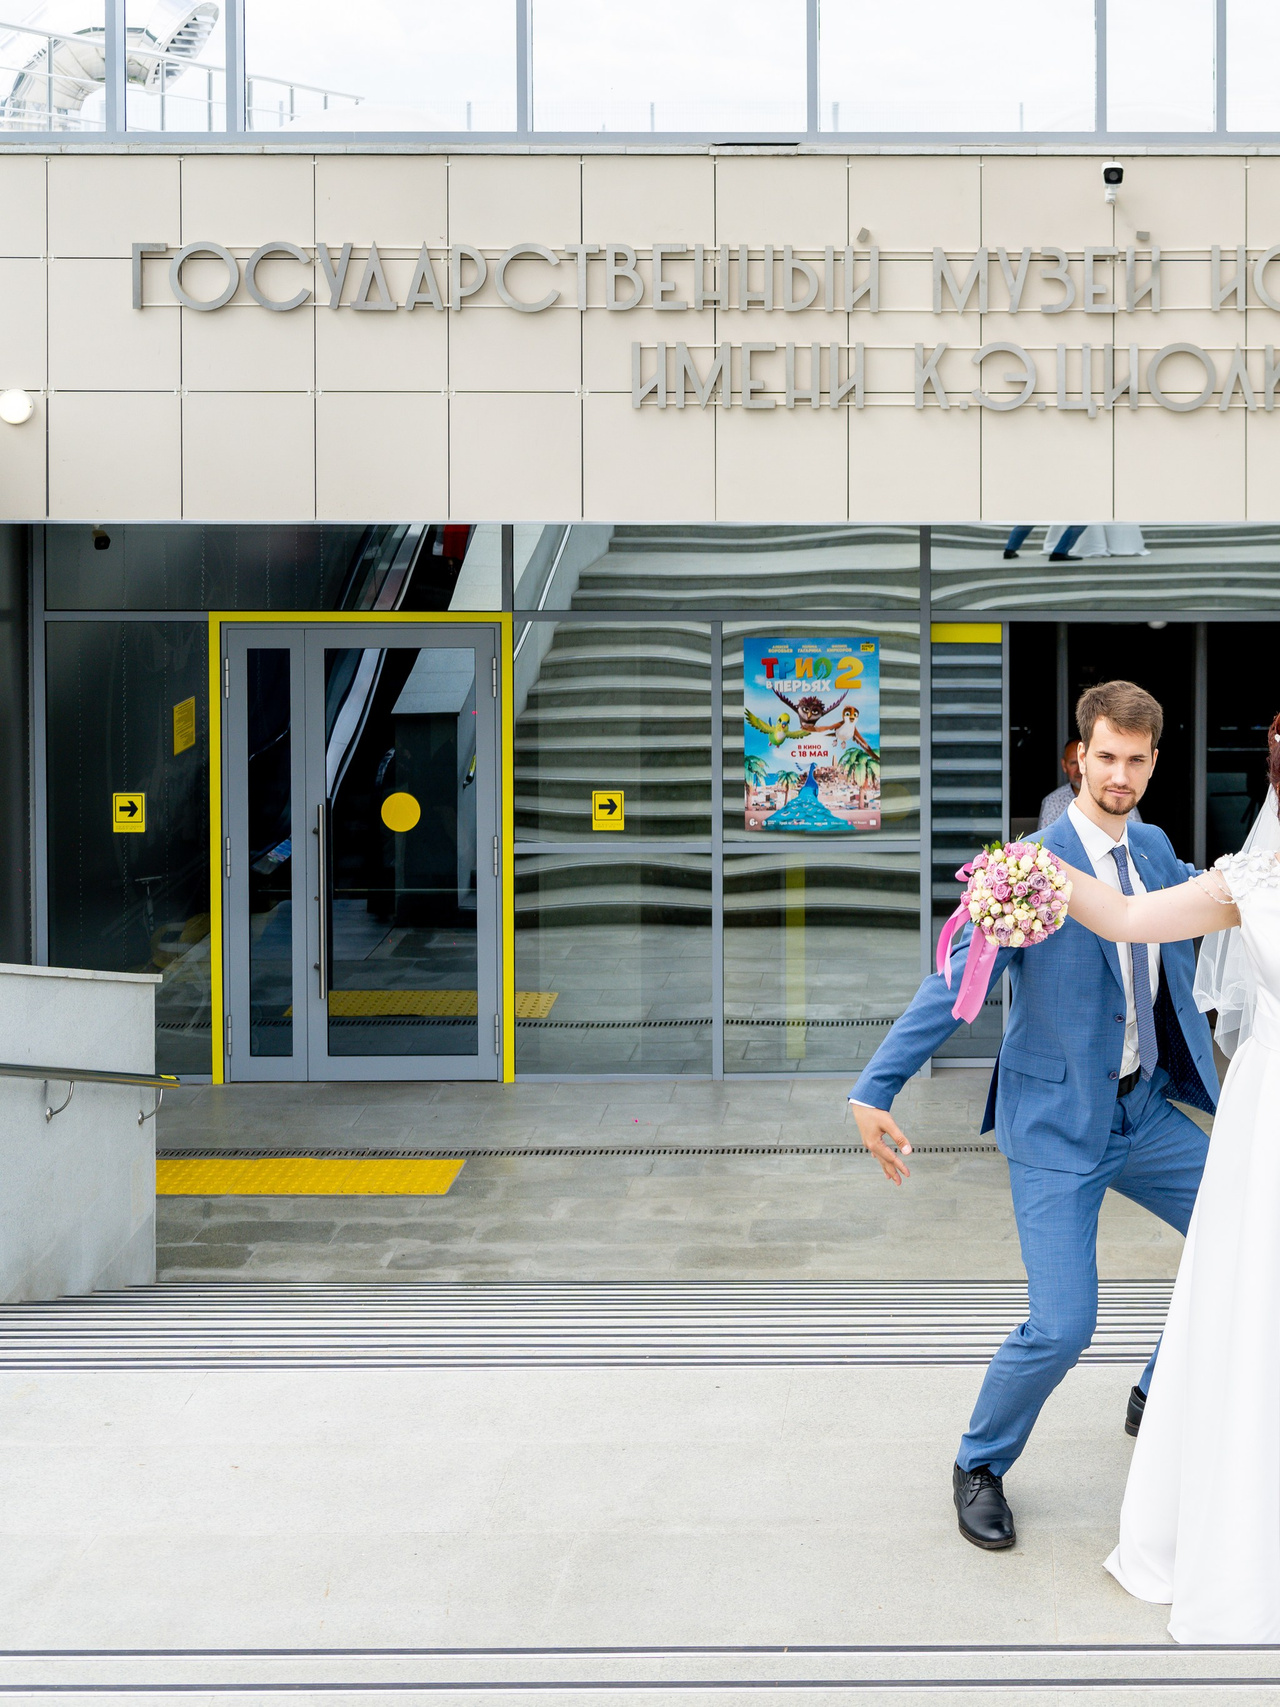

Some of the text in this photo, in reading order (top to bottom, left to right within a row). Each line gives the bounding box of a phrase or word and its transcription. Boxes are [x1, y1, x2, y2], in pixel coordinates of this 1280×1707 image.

[132, 227, 880, 313] ГОСУДАРСТВЕННЫЙ
[932, 231, 1162, 315] МУЗЕЙ
[631, 341, 864, 410] ИМЕНИ
[761, 656, 864, 689] ТРИО 2
[774, 680, 832, 693] ПЕРЬЯХ
[791, 750, 829, 758] С 18 МАЯ
[749, 818, 758, 827] 6+
